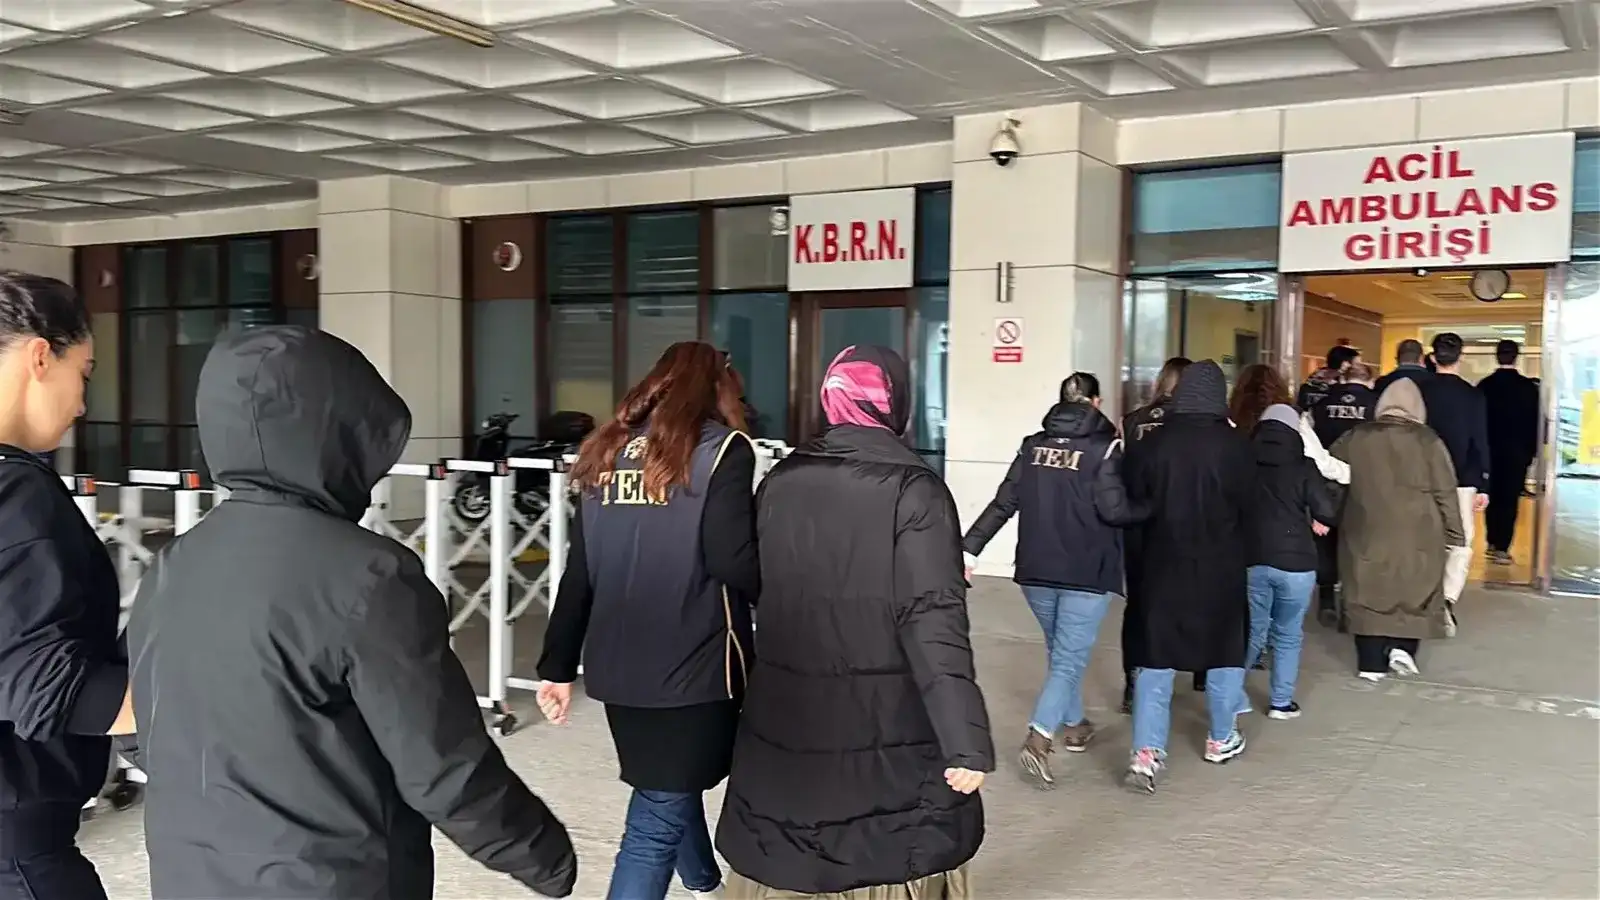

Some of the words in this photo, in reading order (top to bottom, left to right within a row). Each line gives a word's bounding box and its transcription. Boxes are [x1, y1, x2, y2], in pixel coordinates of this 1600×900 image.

[1363, 145, 1474, 184] ACİL
[1287, 182, 1559, 227] AMBULANS
[794, 219, 906, 263] K.B.R.N.
[1344, 220, 1492, 264] GİRİŞİ
[1327, 404, 1367, 420] TEM
[1031, 446, 1085, 472] TEM
